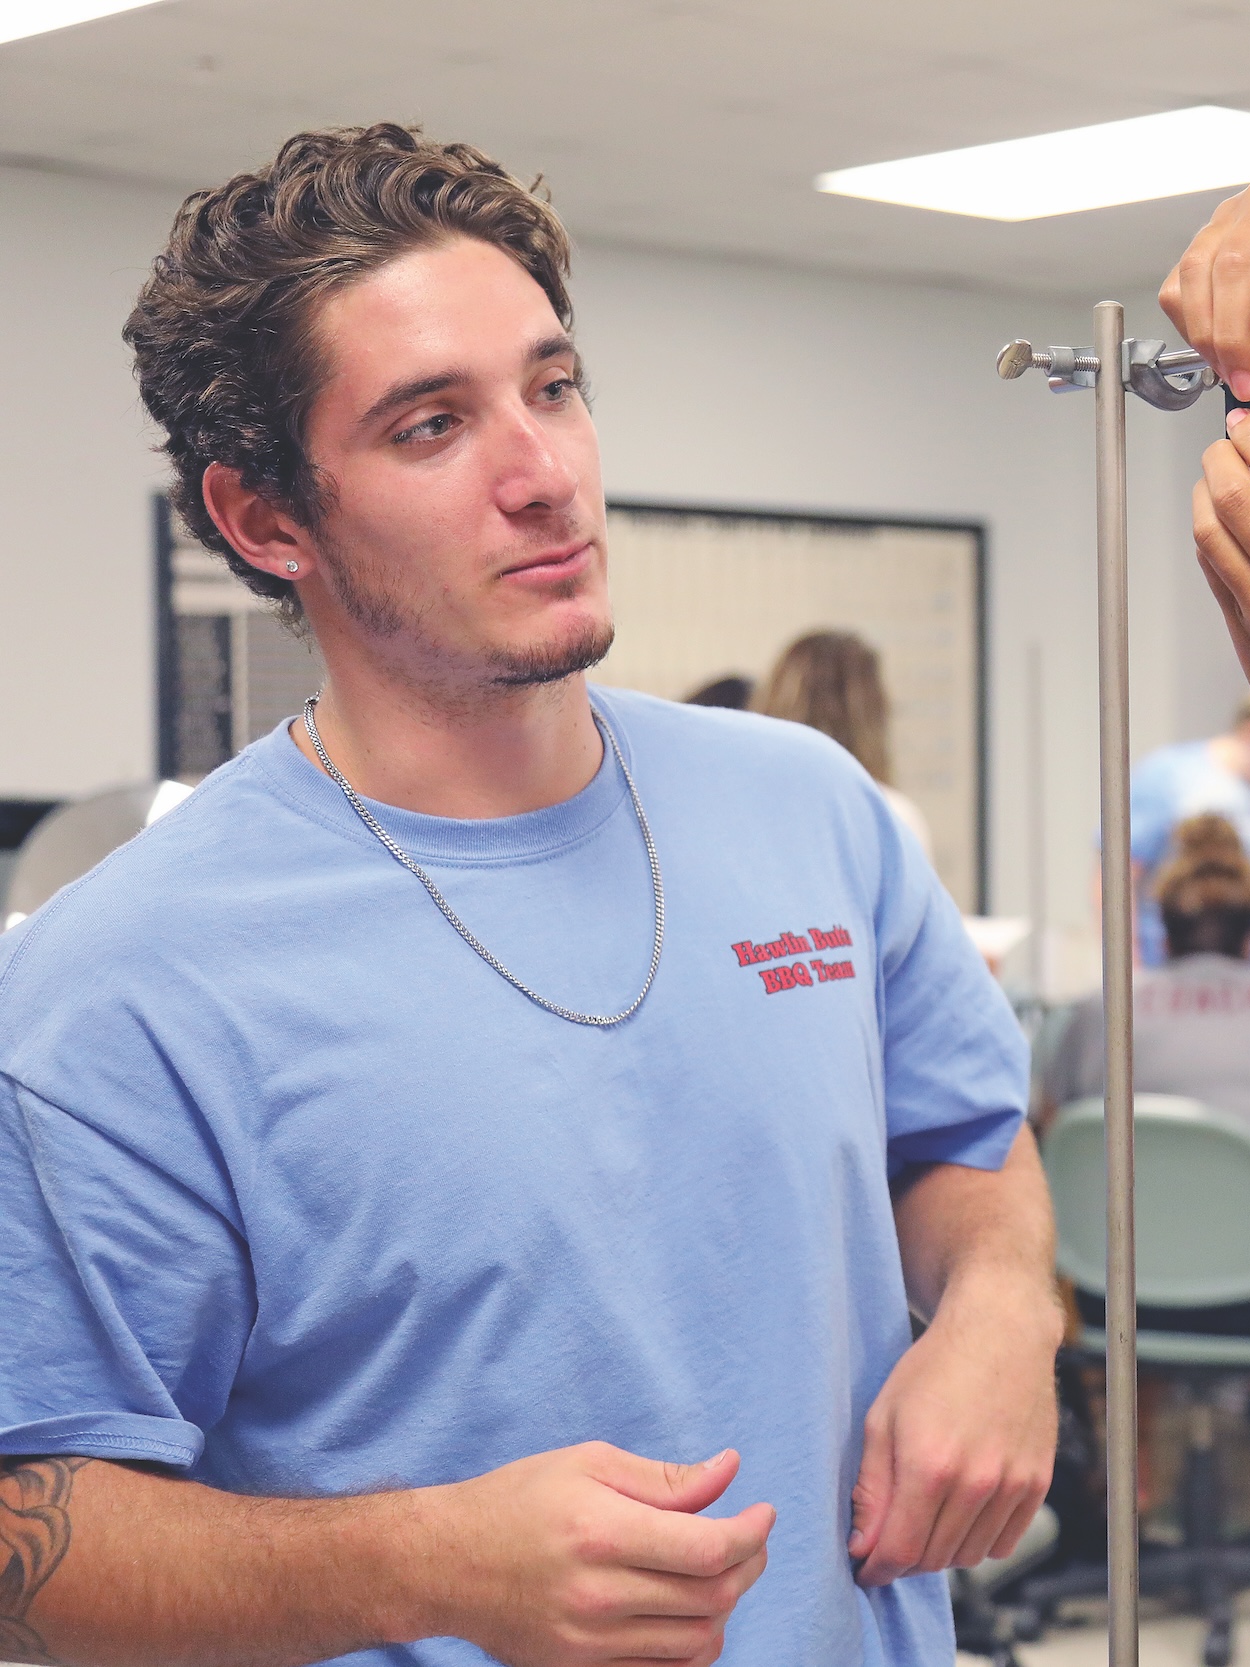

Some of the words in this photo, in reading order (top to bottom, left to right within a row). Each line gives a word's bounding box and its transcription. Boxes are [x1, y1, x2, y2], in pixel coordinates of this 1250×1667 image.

[731, 931, 812, 967] Hawlin
[758, 962, 813, 994] BBQ
[809, 959, 855, 982] Team
